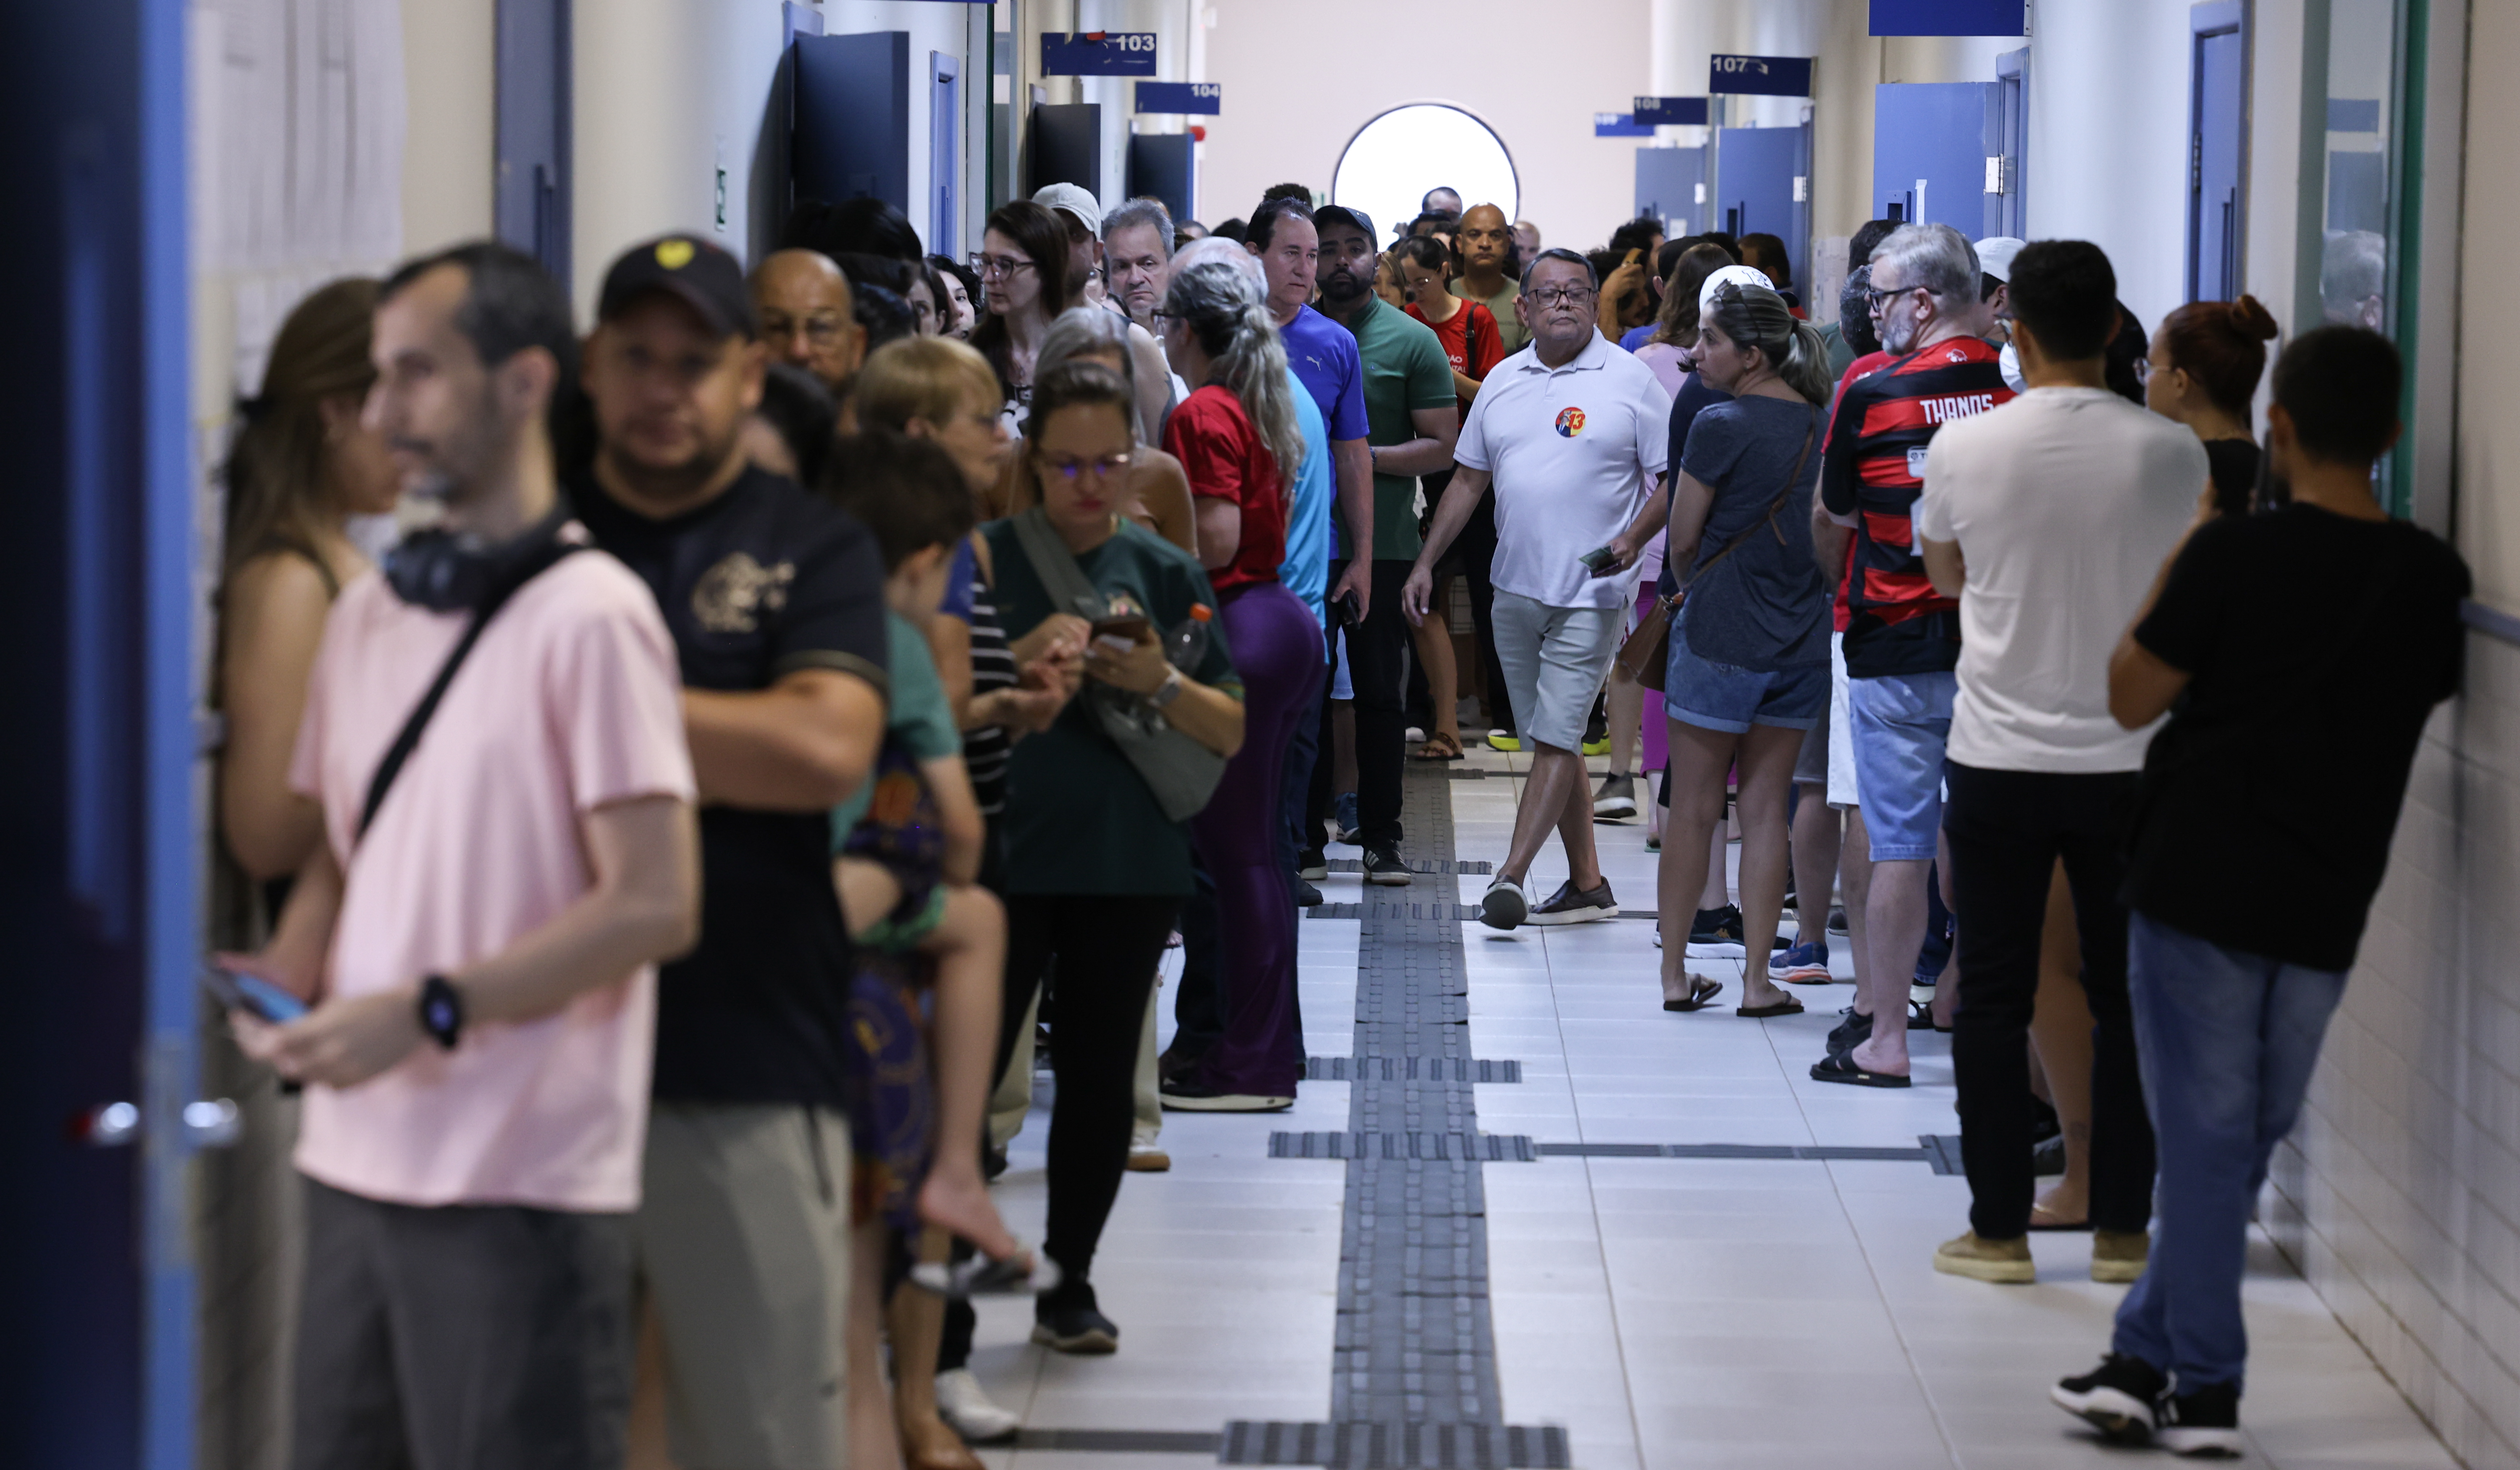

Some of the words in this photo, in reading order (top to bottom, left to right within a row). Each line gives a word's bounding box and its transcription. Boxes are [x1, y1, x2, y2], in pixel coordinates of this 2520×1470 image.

[1116, 35, 1155, 52] 103
[1713, 56, 1748, 73] 107
[1191, 84, 1219, 97] 104
[1448, 354, 1463, 363] ÃO
[1452, 365, 1466, 373] TAL
[1919, 394, 1995, 424] THANOS
[1568, 414, 1586, 430] 13
